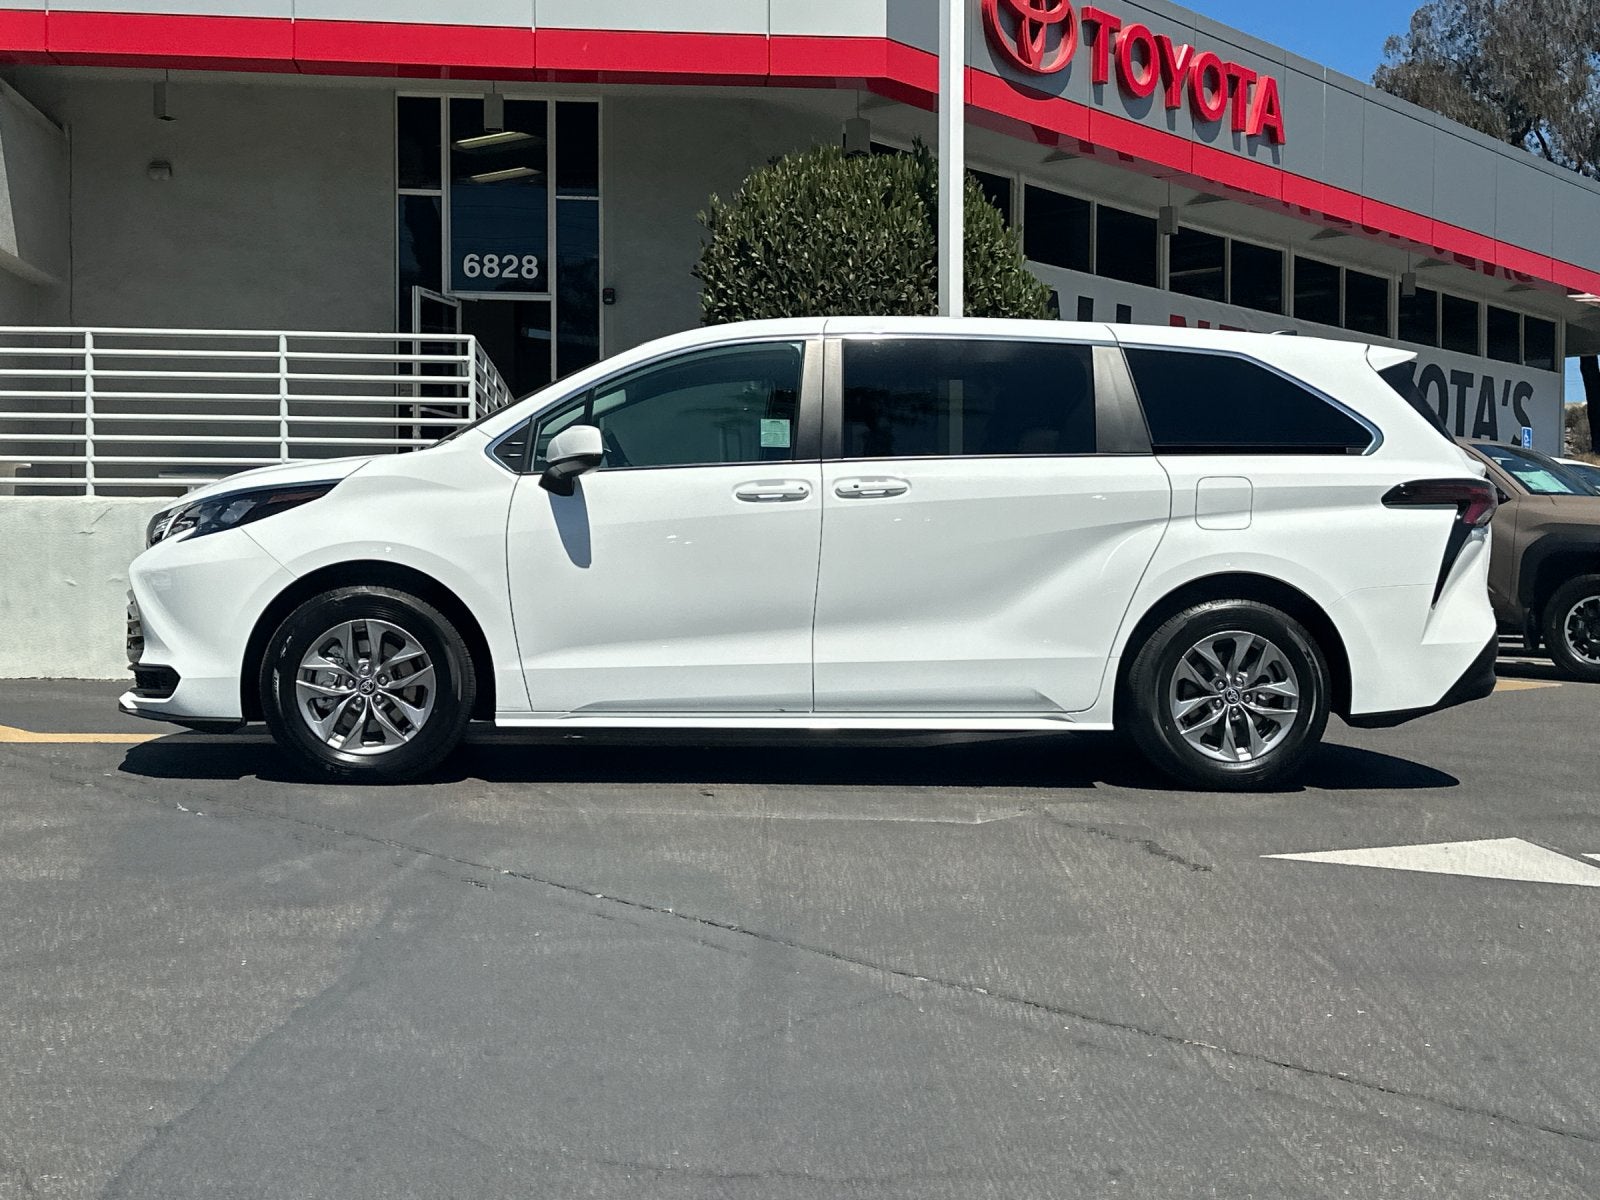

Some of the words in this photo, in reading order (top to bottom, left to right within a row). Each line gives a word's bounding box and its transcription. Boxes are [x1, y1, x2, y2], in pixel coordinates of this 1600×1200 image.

[1081, 6, 1286, 144] TOYOTA
[463, 253, 539, 279] 6828
[1407, 361, 1534, 446] OTA'S
